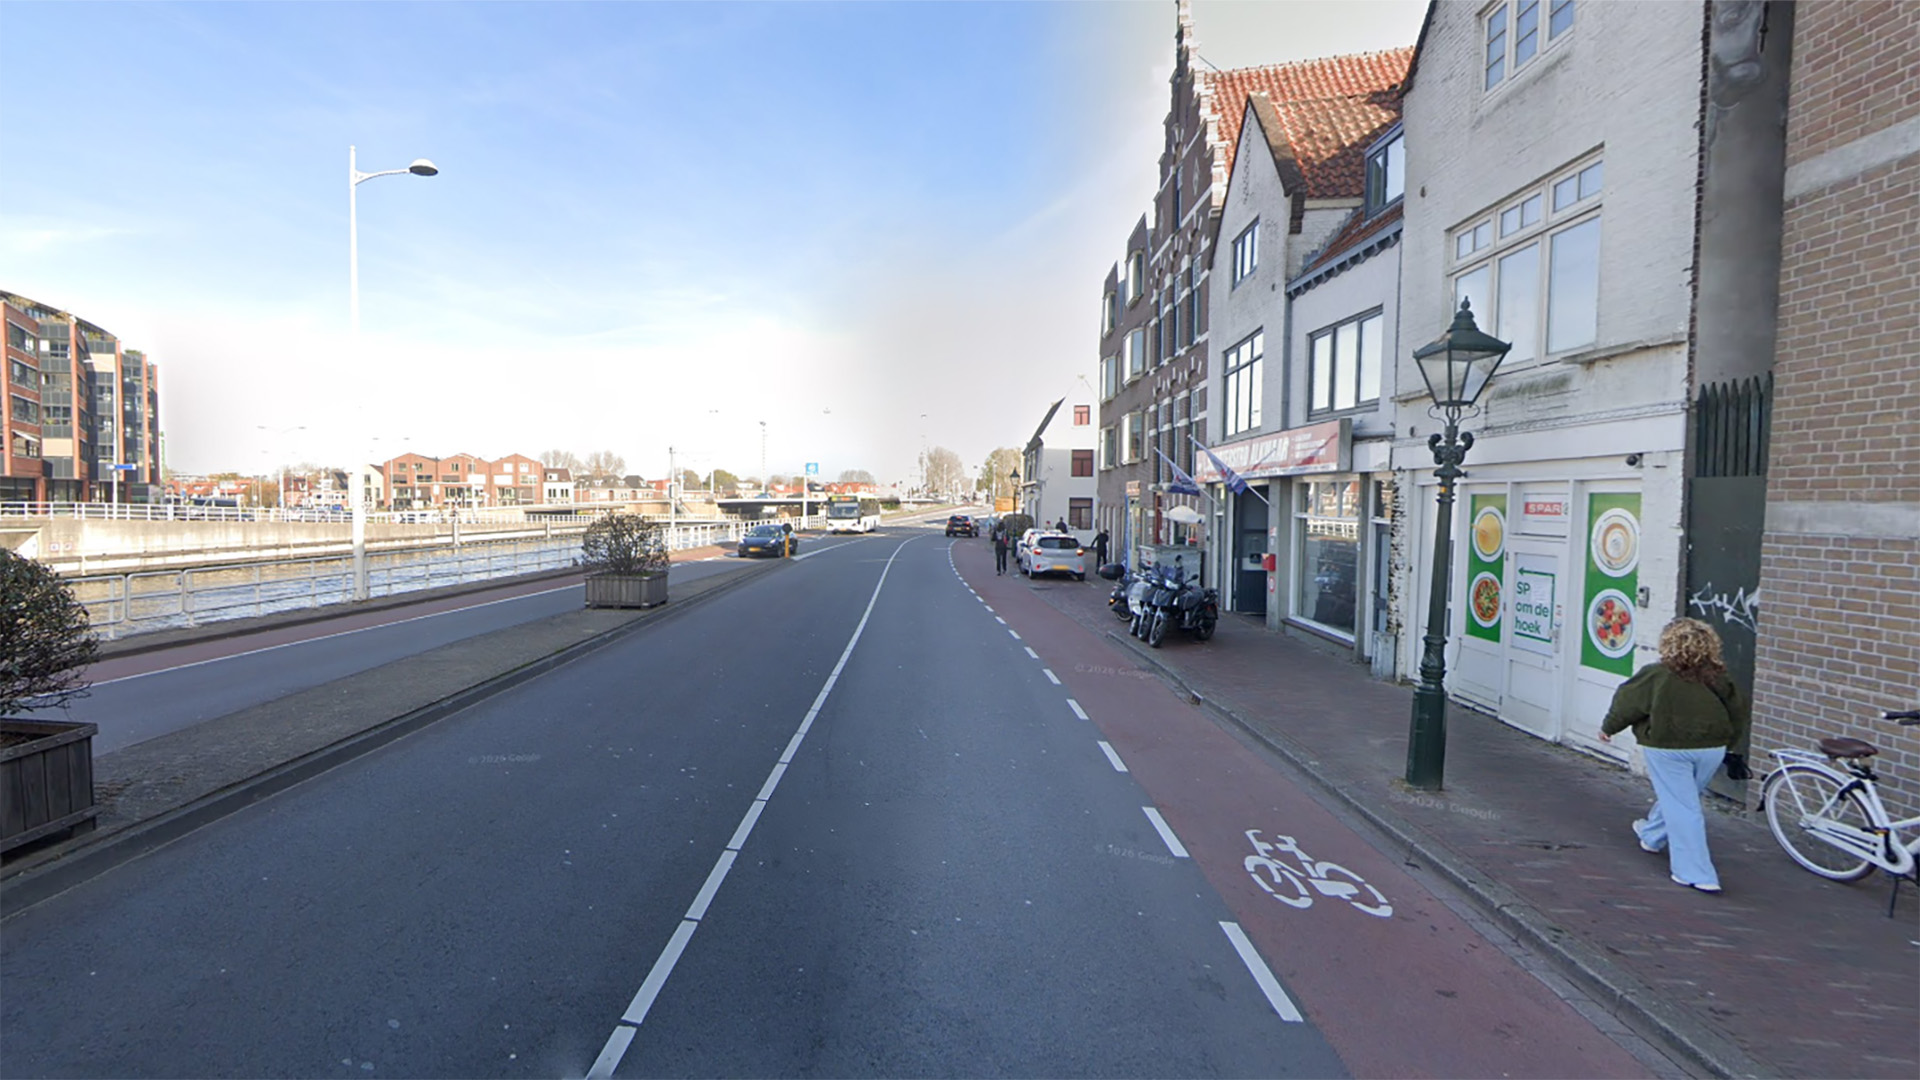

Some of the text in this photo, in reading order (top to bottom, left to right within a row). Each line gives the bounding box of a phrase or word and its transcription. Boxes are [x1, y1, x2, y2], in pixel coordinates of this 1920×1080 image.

[1528, 502, 1561, 514] SPAR
[1516, 581, 1531, 595] SP
[1515, 602, 1549, 618] om de
[1514, 616, 1541, 635] hoek
